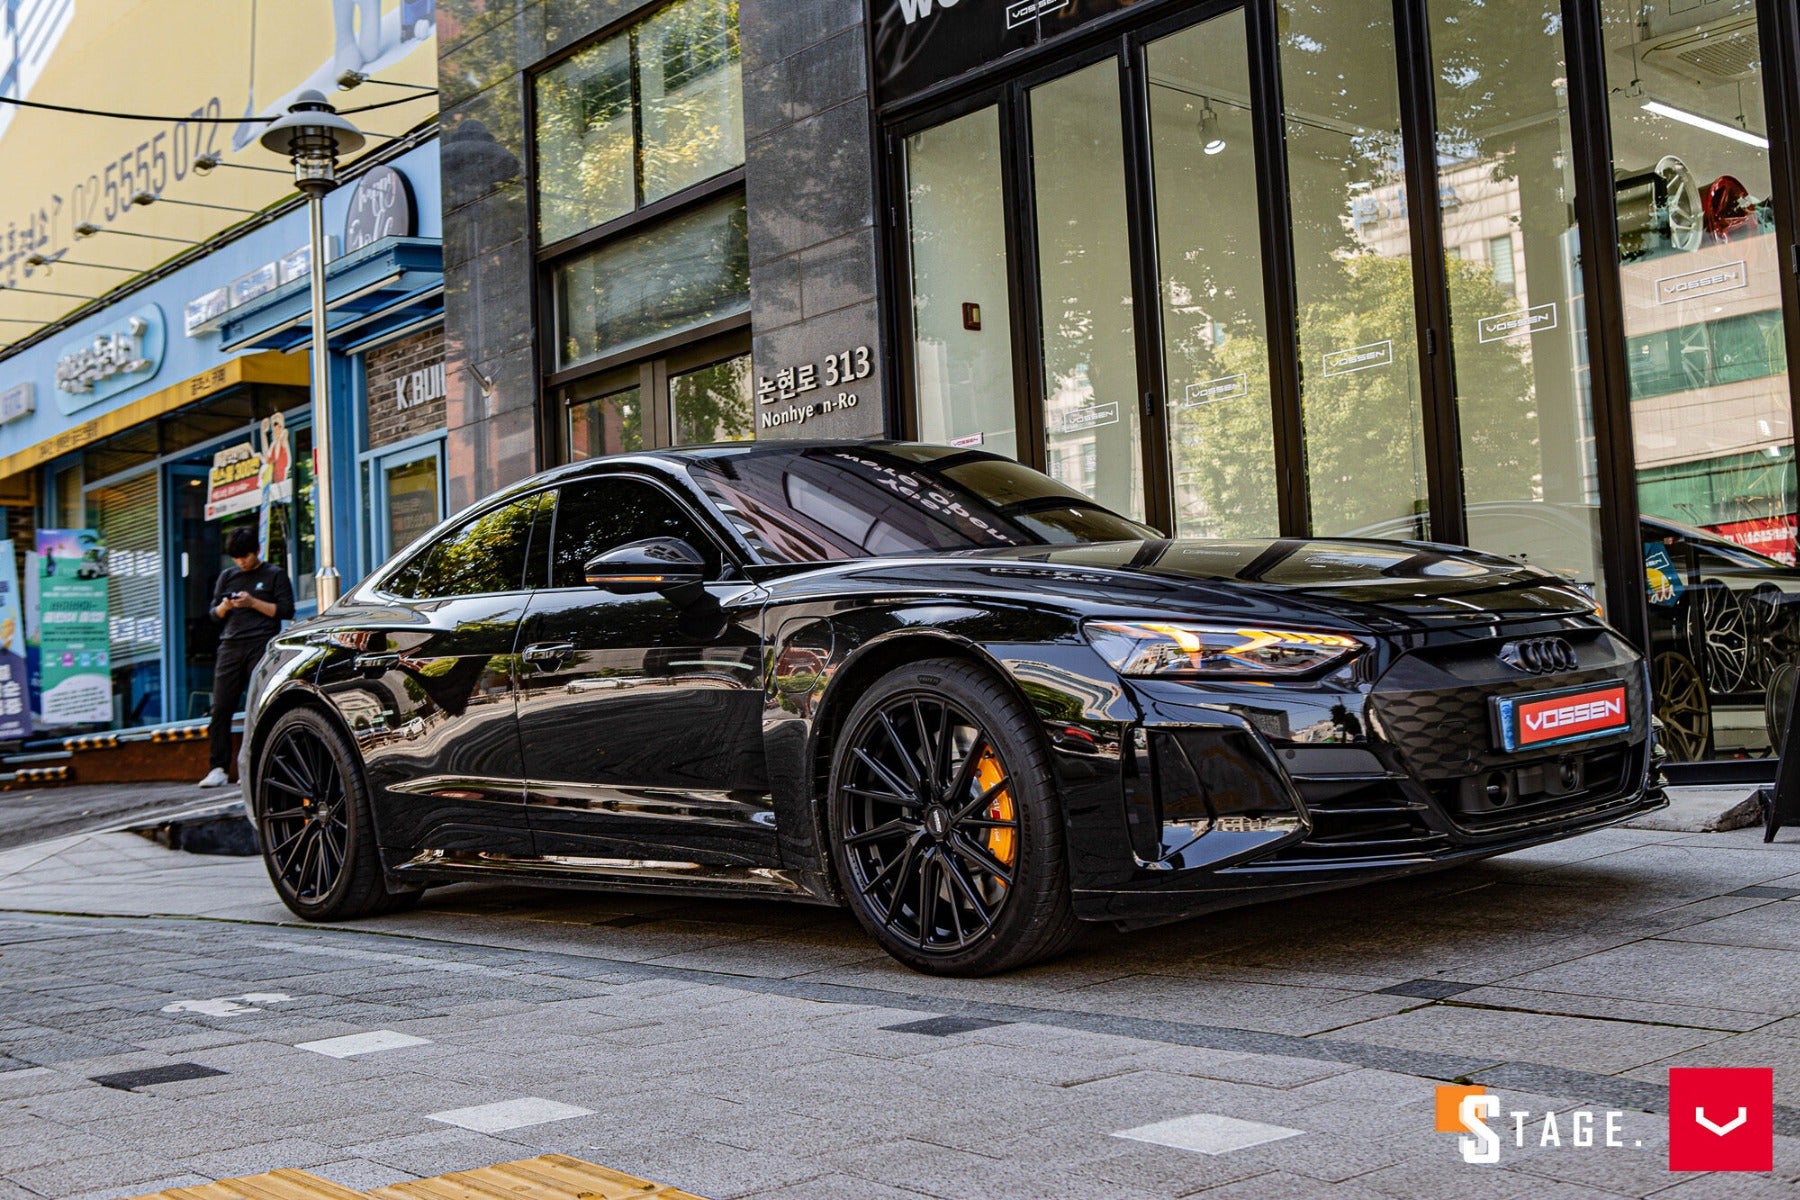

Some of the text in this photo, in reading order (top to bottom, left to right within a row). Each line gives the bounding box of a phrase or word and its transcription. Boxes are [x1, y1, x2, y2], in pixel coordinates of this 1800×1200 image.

[1664, 272, 1737, 294] VOSSEN
[1486, 313, 1549, 333] VOSSEN
[1330, 349, 1386, 368] VOSSEN
[757, 345, 871, 405] 논현로 313
[1192, 382, 1241, 399] VOSSEN
[1069, 410, 1114, 425] VOSSEN
[1526, 697, 1620, 731] VOSSEN
